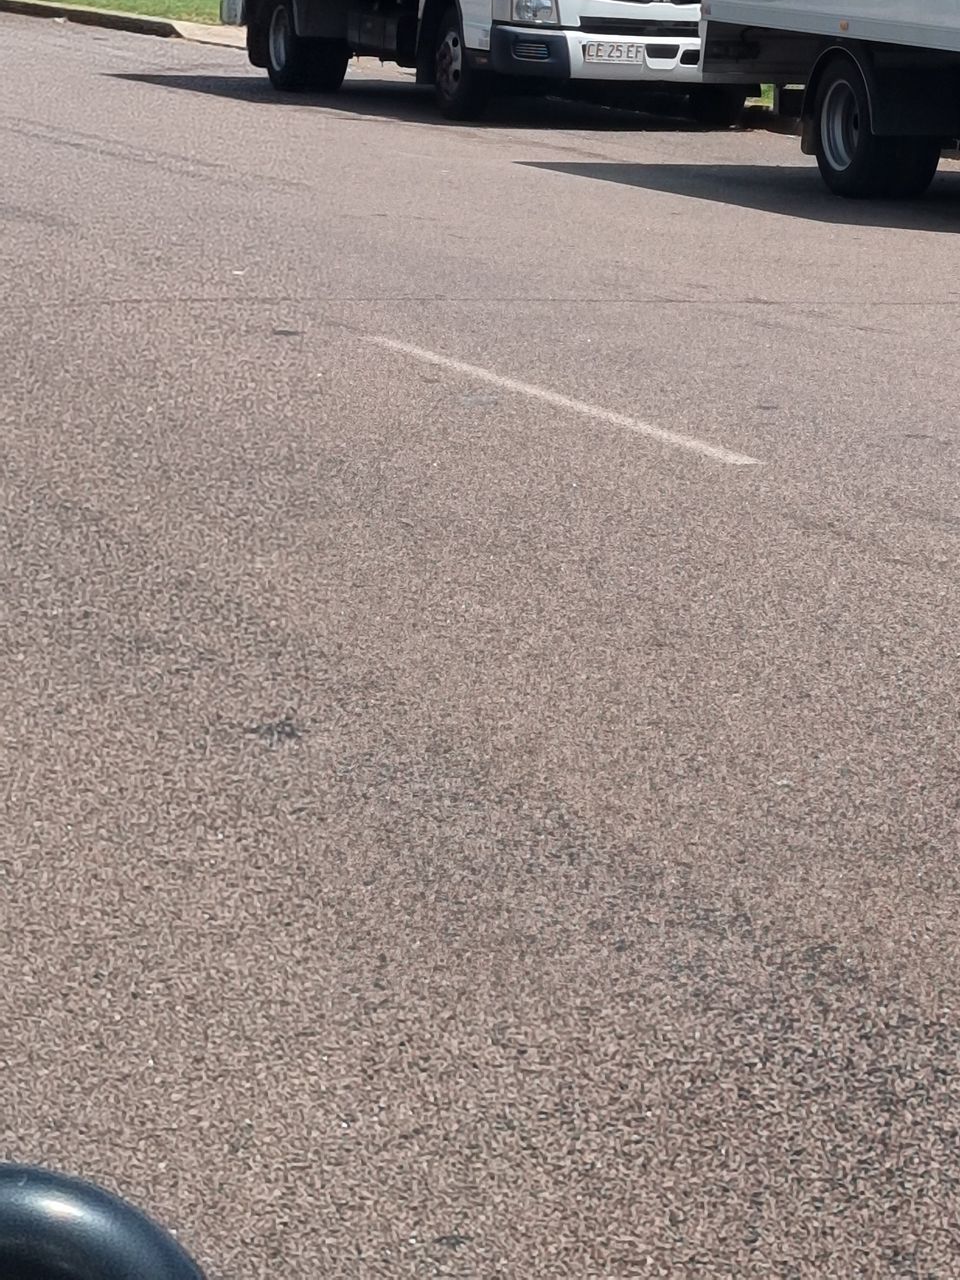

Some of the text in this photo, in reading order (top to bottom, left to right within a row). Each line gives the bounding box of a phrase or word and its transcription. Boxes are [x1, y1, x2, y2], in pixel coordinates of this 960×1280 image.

[587, 43, 643, 60] CE 25 EF
